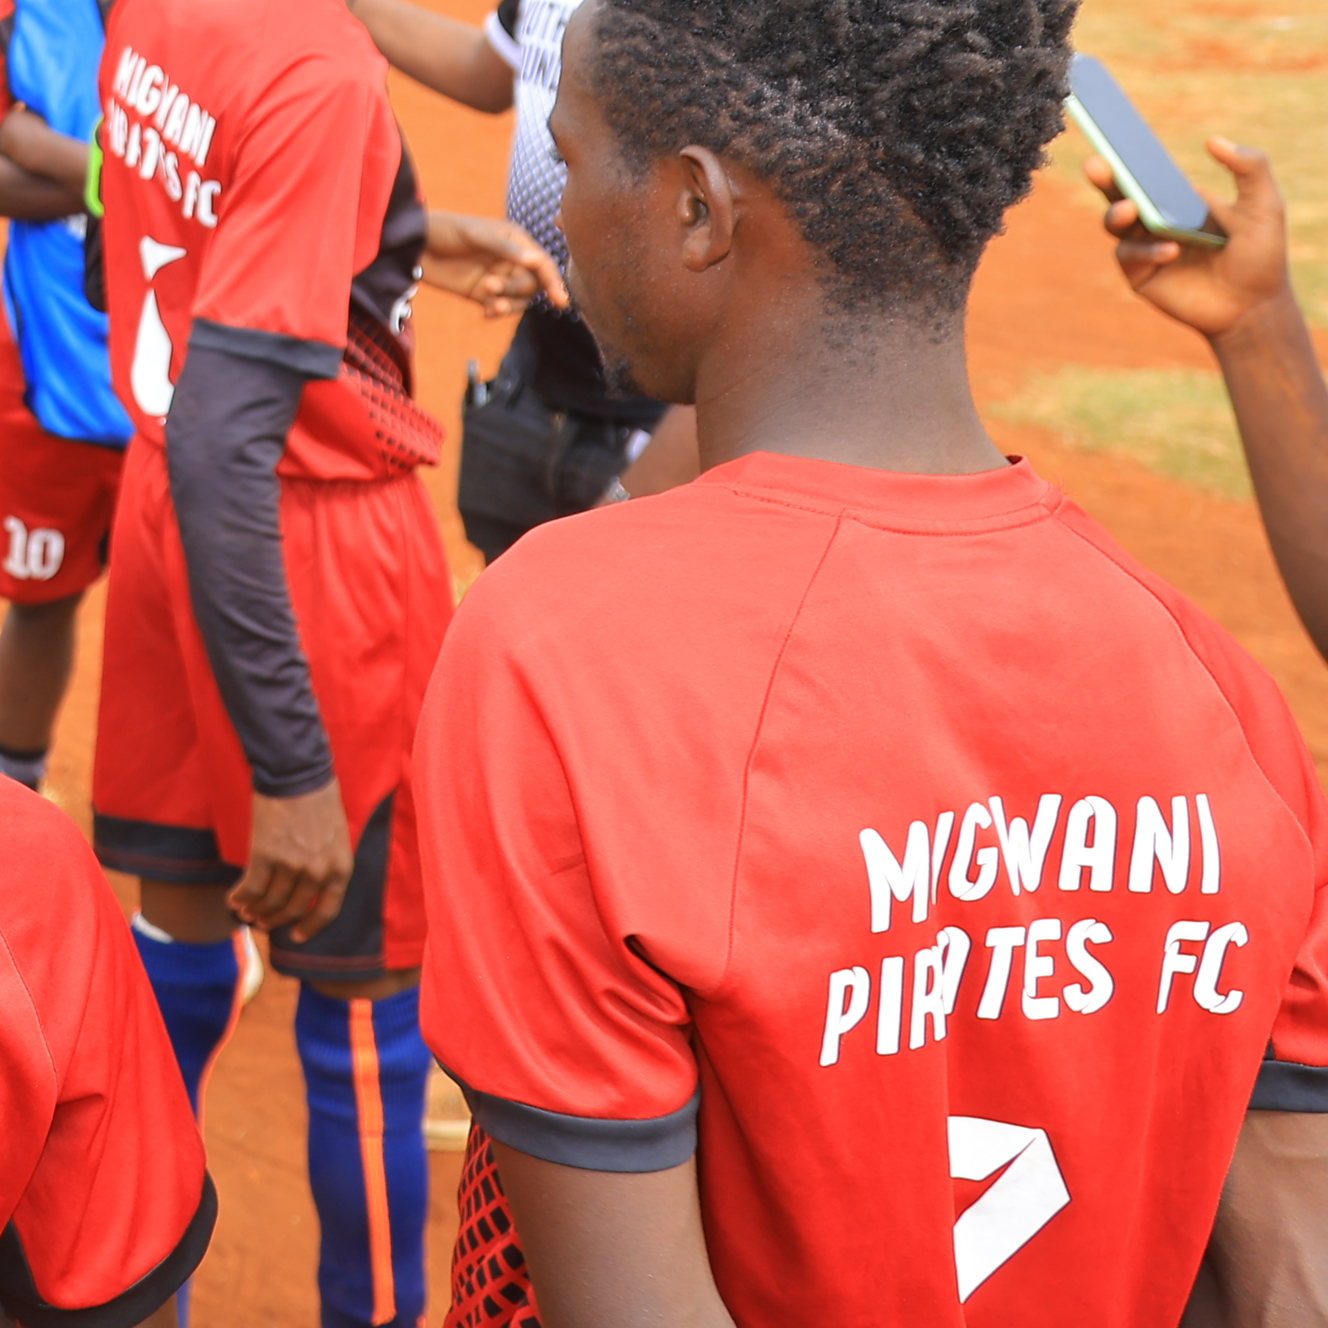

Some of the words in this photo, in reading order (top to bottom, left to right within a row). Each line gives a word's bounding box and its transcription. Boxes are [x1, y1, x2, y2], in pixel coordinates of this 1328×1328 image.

[3, 515, 66, 581] 10
[859, 793, 1221, 934] MIGWANI
[1156, 919, 1250, 1015] FC
